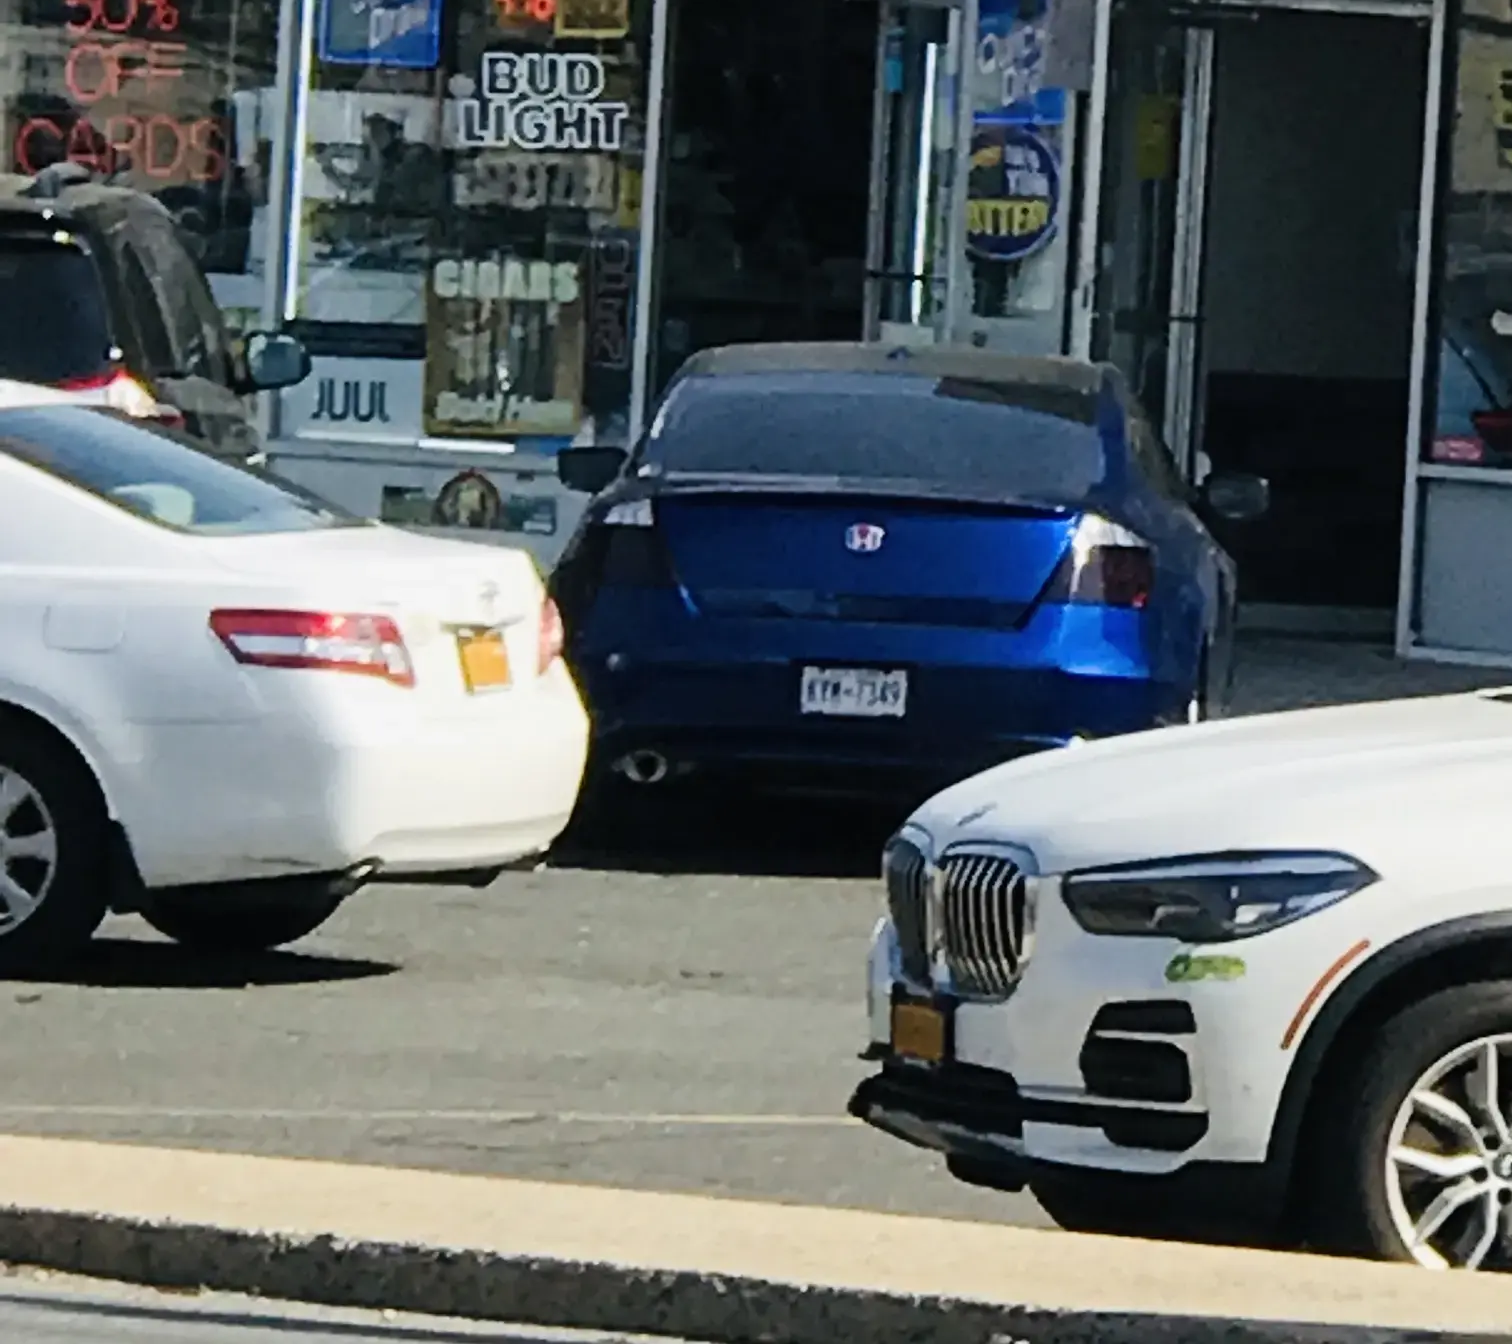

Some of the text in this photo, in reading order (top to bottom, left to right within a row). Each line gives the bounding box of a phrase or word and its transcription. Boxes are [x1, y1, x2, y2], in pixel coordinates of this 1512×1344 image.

[65, 39, 187, 102] OFF
[482, 52, 605, 100] BUD
[15, 112, 227, 181] CARDS
[461, 98, 629, 150] LIGHT
[310, 378, 391, 423] JUUL
